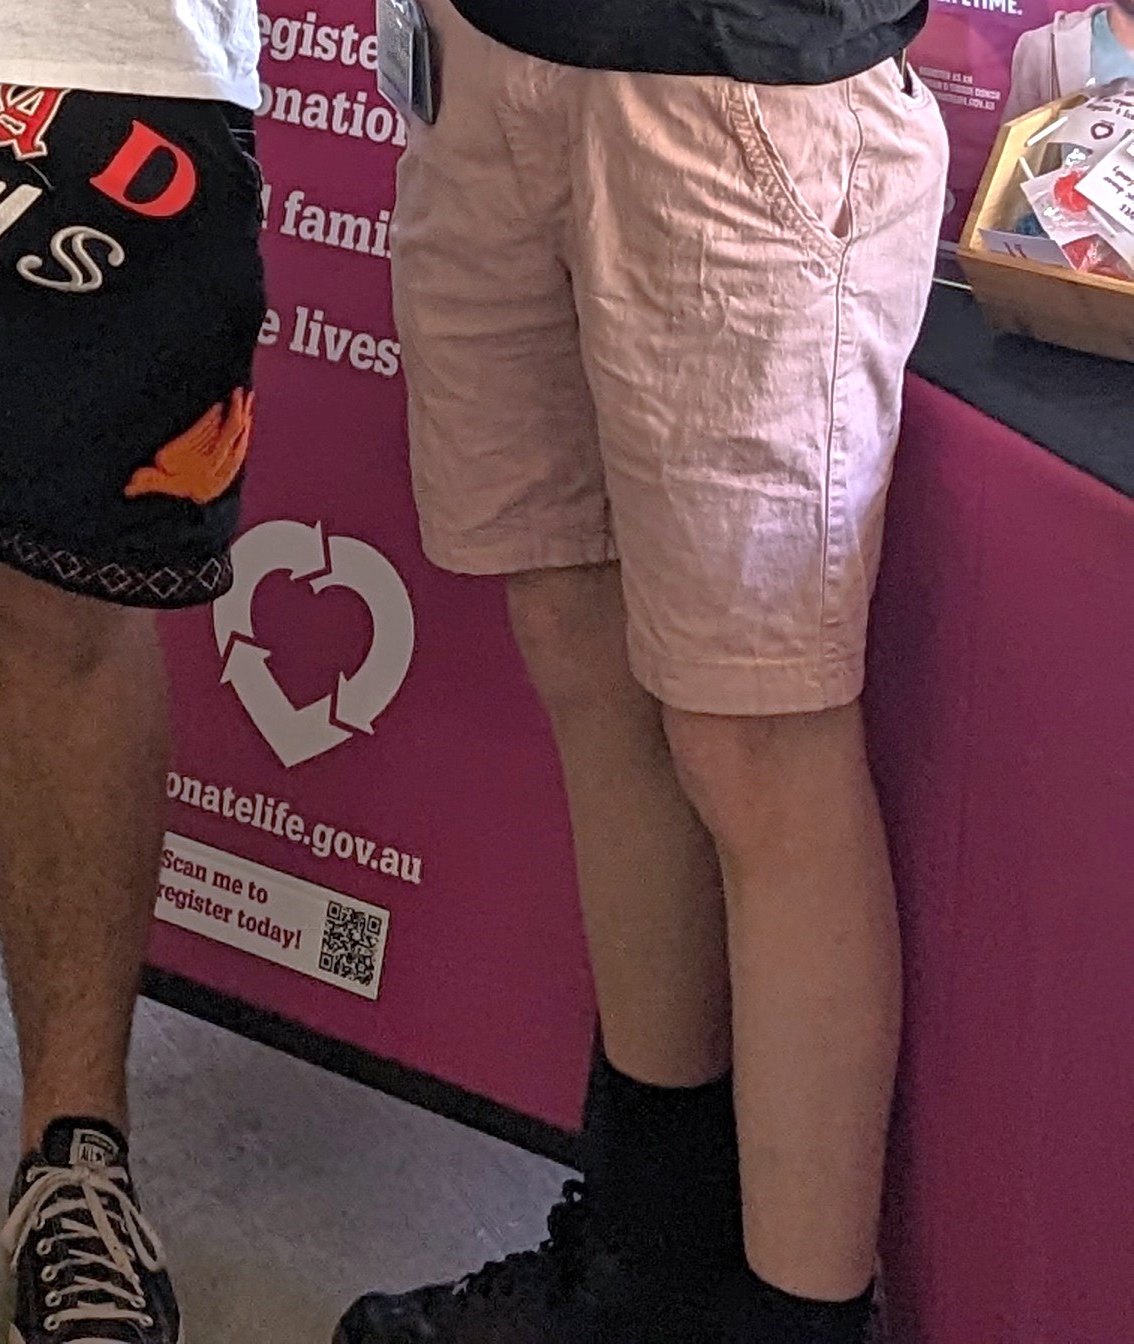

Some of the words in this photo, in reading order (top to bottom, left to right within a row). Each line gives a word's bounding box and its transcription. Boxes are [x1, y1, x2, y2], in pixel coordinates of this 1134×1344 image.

[167, 771, 424, 885] onatelife.gov.au
[162, 848, 207, 883] Scan
[212, 870, 243, 896] me
[248, 880, 269, 905] to
[237, 910, 303, 951] today!
